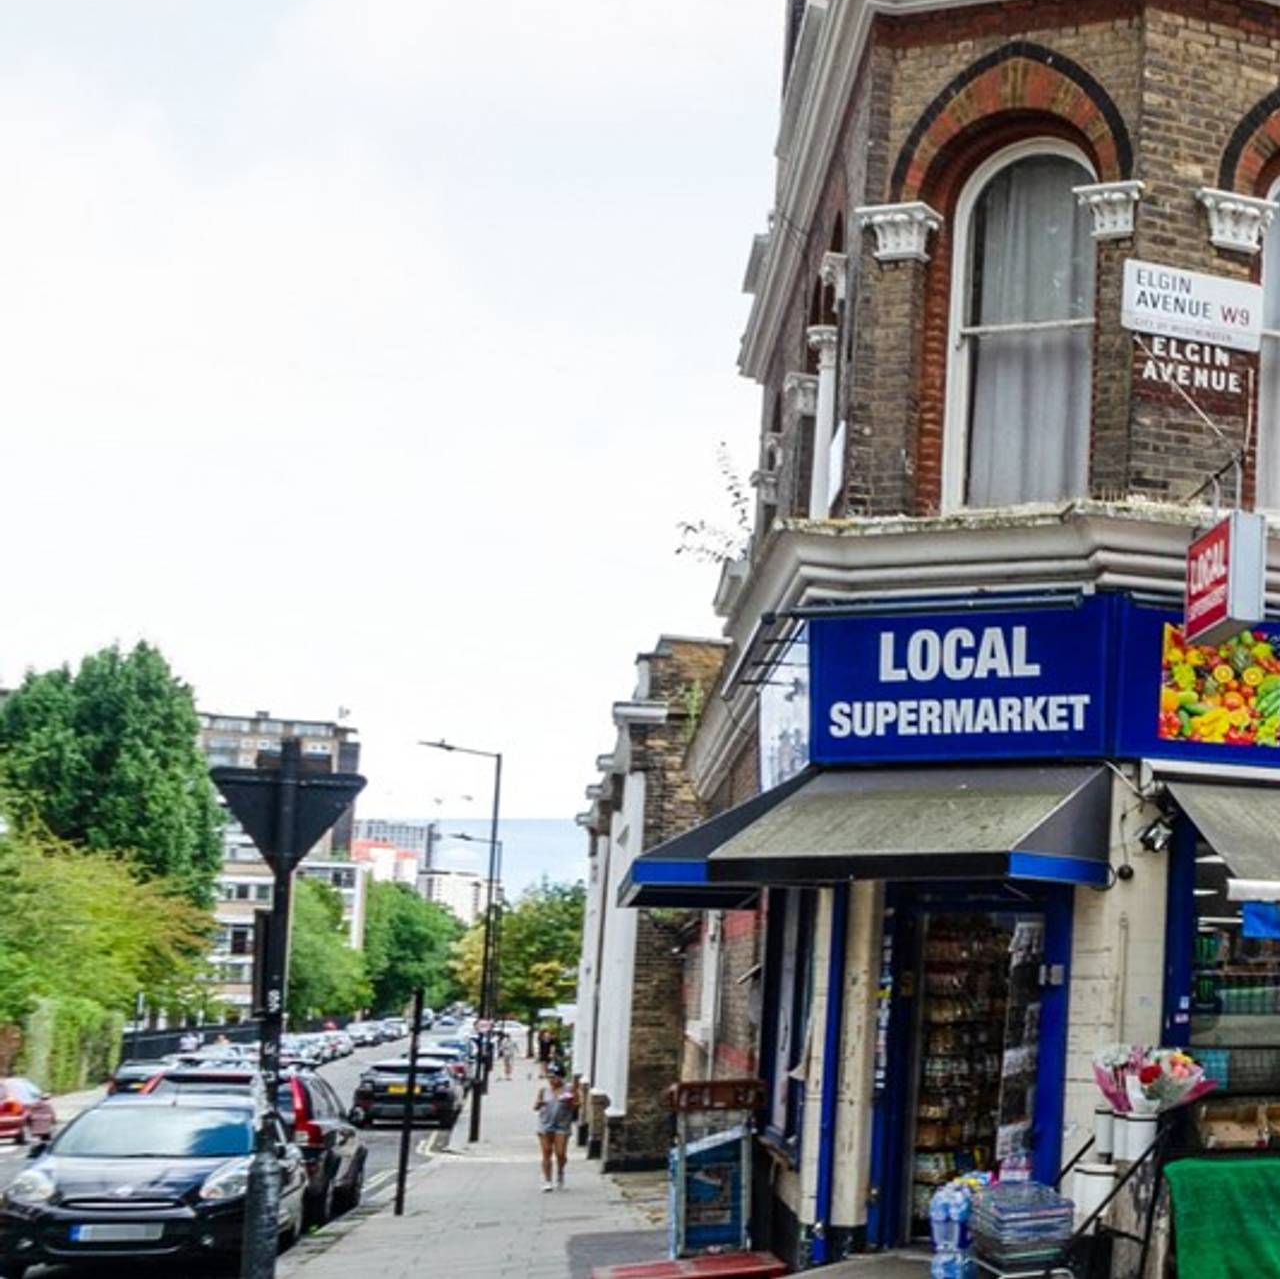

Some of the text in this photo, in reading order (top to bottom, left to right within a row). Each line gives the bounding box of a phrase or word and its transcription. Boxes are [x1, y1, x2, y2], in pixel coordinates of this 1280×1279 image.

[1137, 269, 1192, 294] ELGIN
[1136, 290, 1250, 327] AVENUE W9
[1152, 336, 1231, 368] ELGIN
[1142, 360, 1243, 394] AVENUE
[878, 625, 1040, 683] LOCAL
[829, 694, 1090, 738] SUPERMARKET
